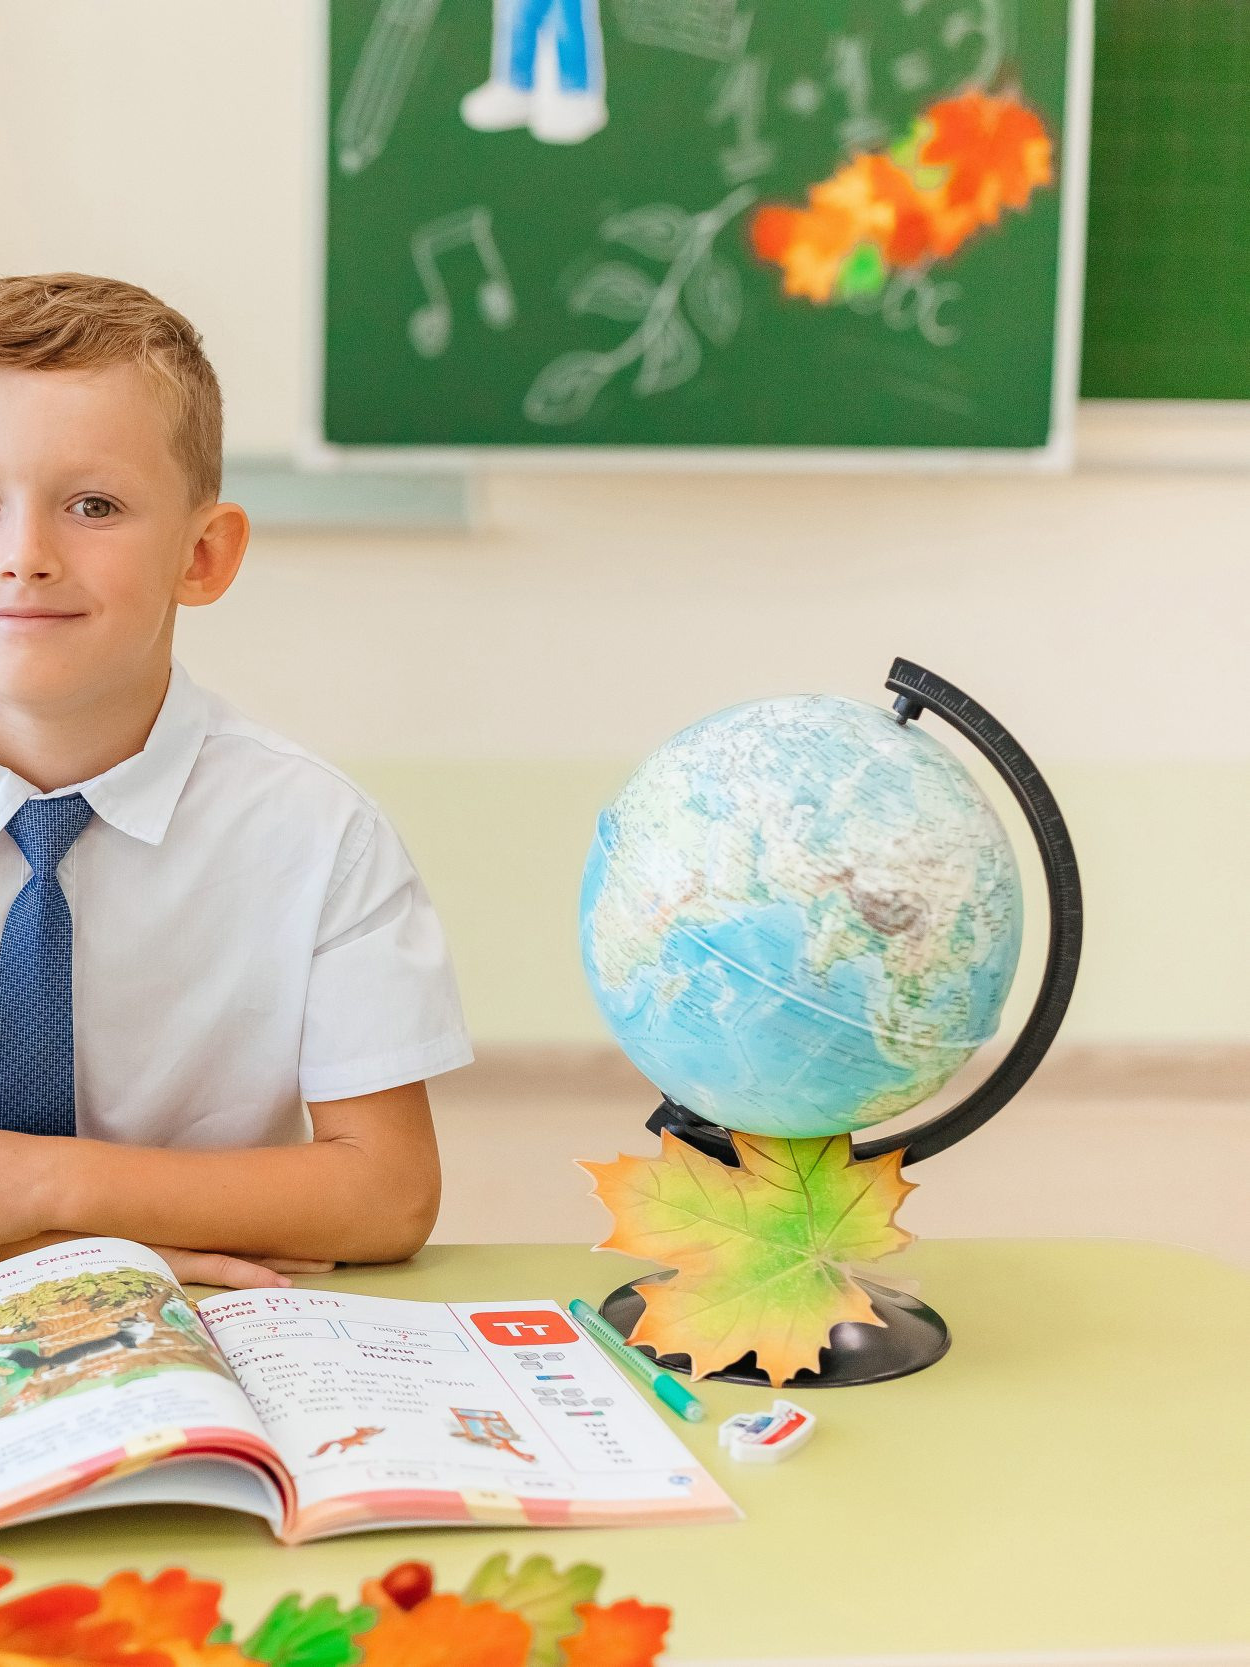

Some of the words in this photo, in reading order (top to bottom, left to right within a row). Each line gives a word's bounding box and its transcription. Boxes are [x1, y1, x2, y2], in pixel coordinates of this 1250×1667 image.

[36, 1248, 102, 1266] Сказки
[201, 1301, 253, 1319] Звуки
[205, 1309, 256, 1327] Буква
[492, 1321, 550, 1337] Тт
